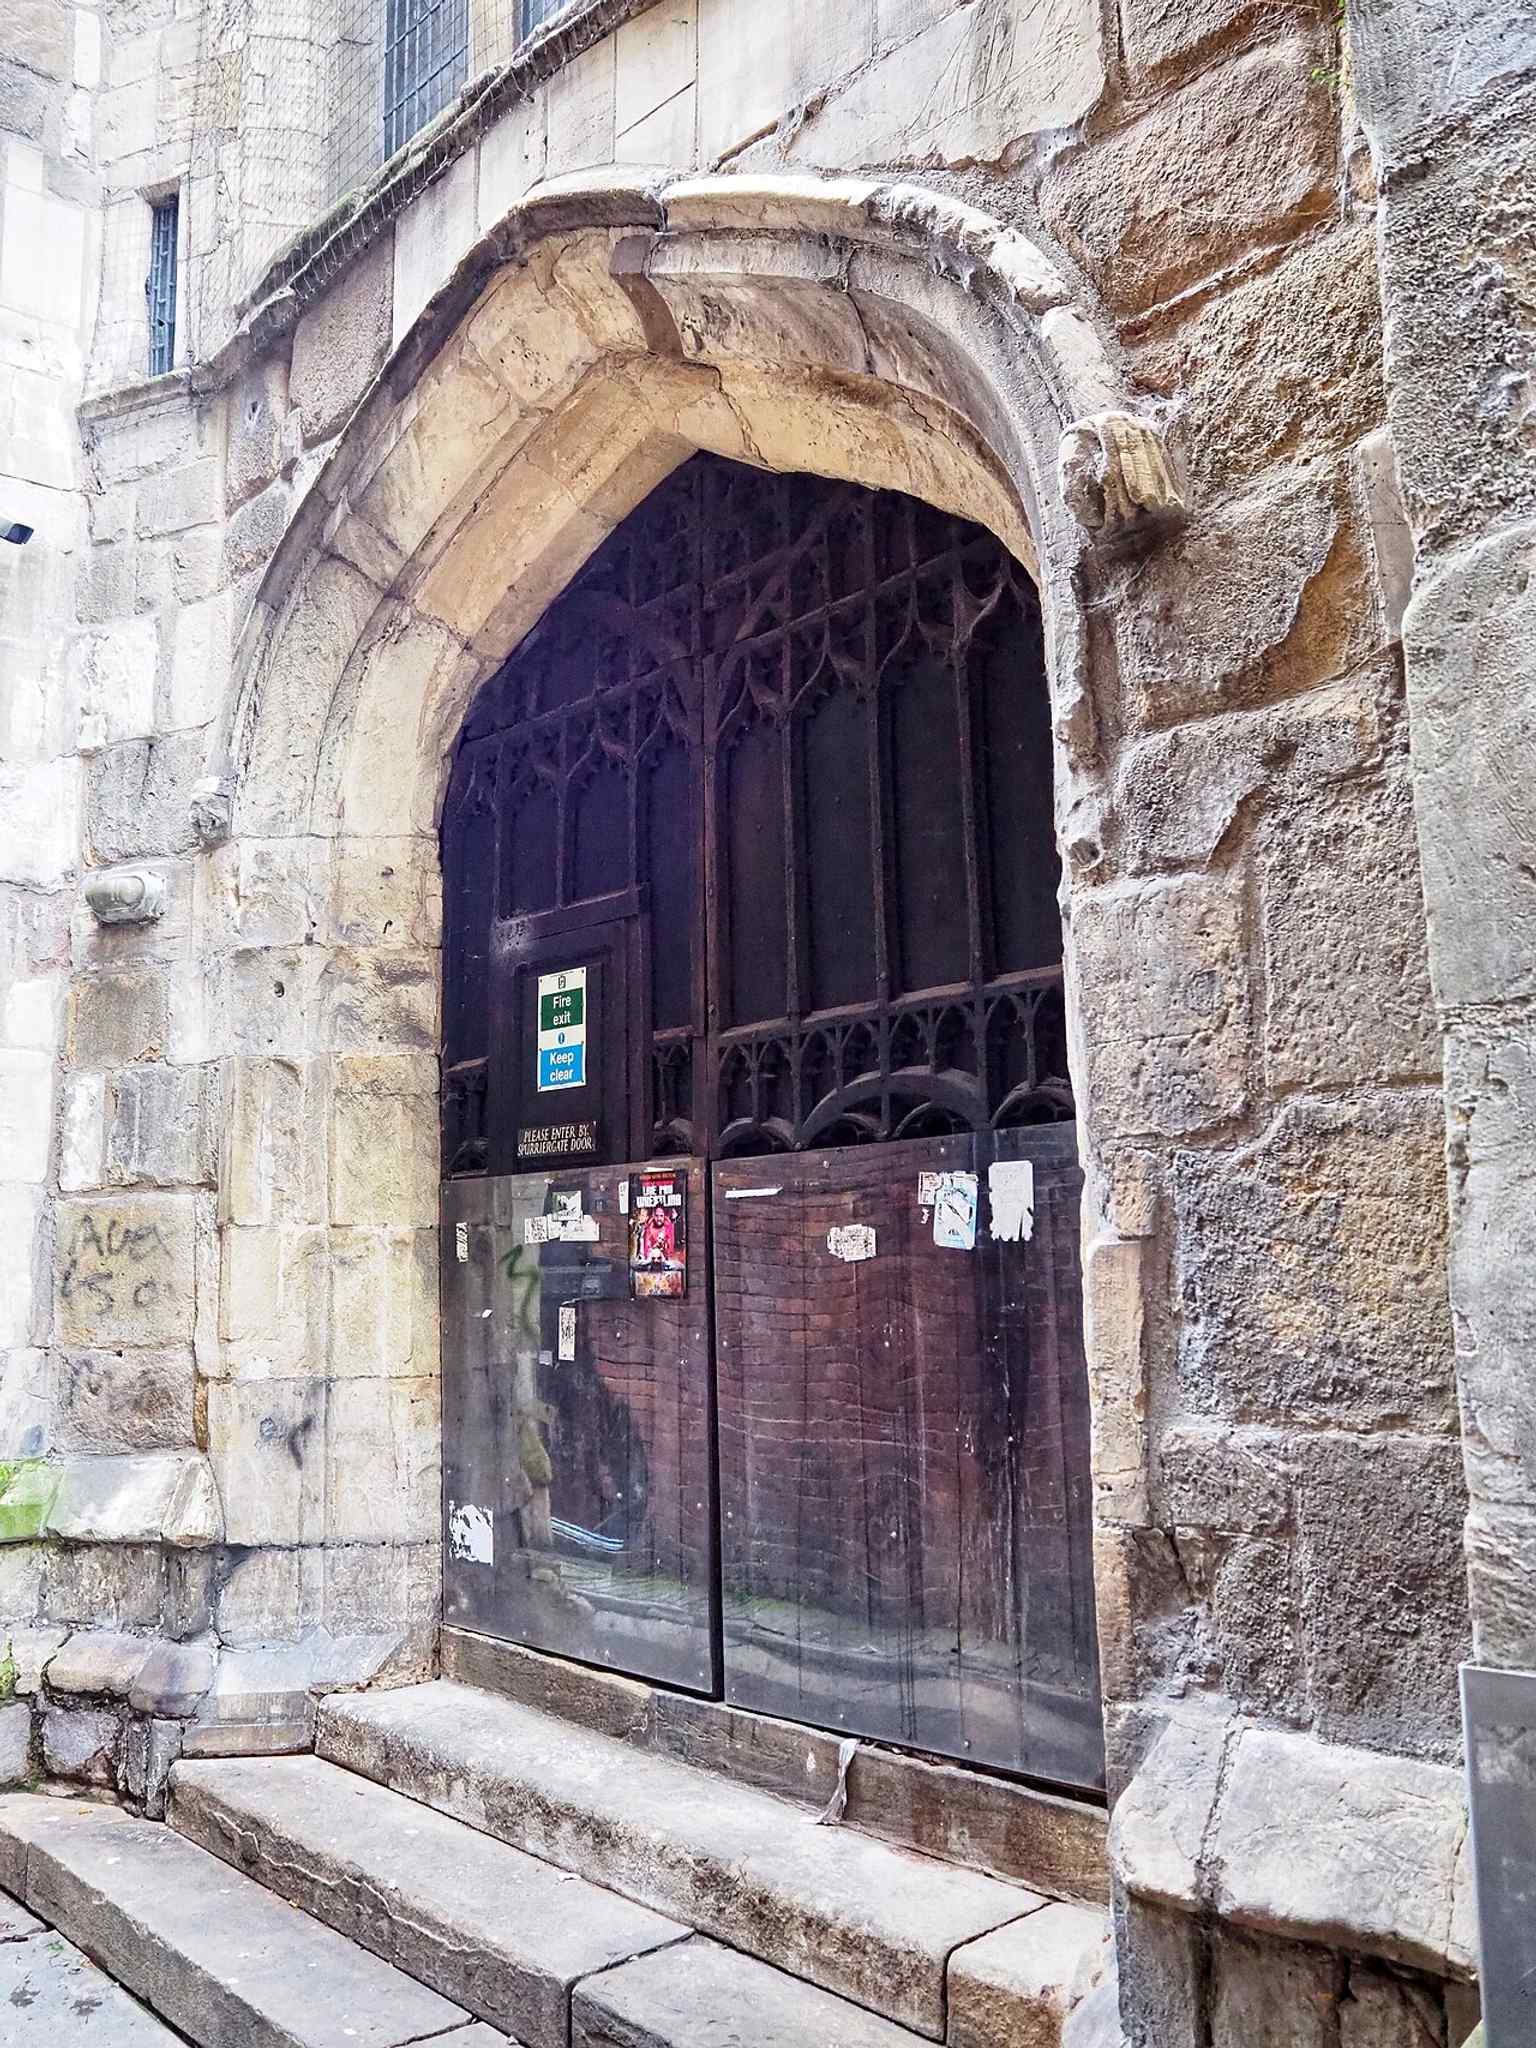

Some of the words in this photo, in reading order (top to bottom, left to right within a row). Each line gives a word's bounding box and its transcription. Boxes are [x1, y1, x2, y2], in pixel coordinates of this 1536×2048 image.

[553, 995, 571, 1009] Fire
[553, 1011, 571, 1026] exit
[549, 1051, 574, 1066] Keep
[549, 1067, 573, 1082] clear
[523, 1128, 549, 1142] PLEASE
[551, 1125, 576, 1140] ENTER
[570, 1136, 592, 1151] DOOR
